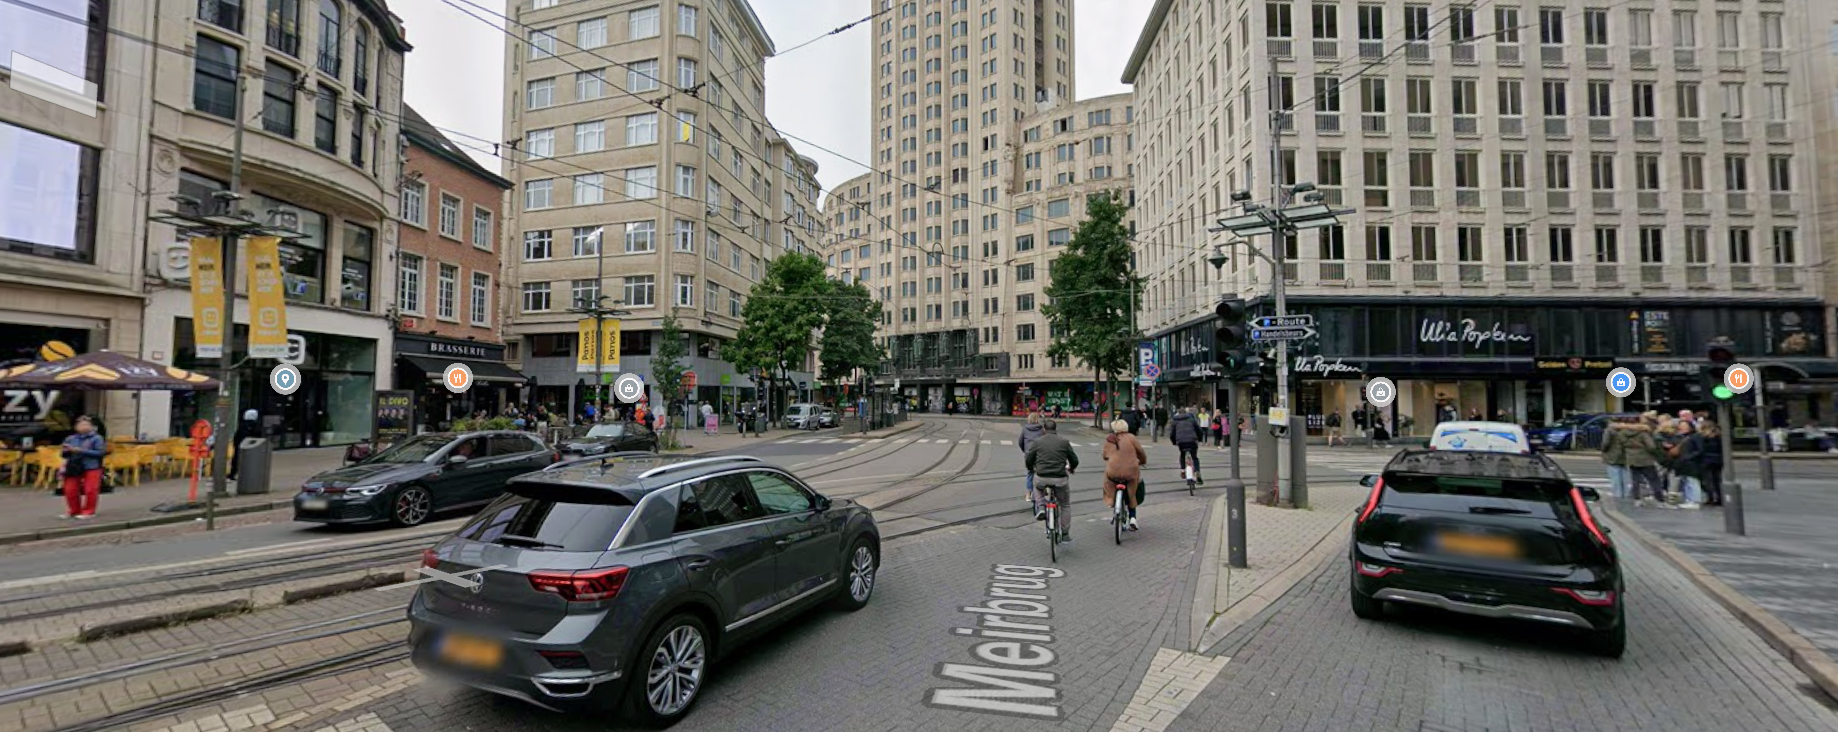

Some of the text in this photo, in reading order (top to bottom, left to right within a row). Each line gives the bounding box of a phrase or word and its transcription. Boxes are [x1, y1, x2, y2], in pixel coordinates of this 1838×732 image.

[1461, 318, 1531, 348] Popken
[430, 342, 486, 356] BRASSERIE
[389, 397, 409, 405] DIVO
